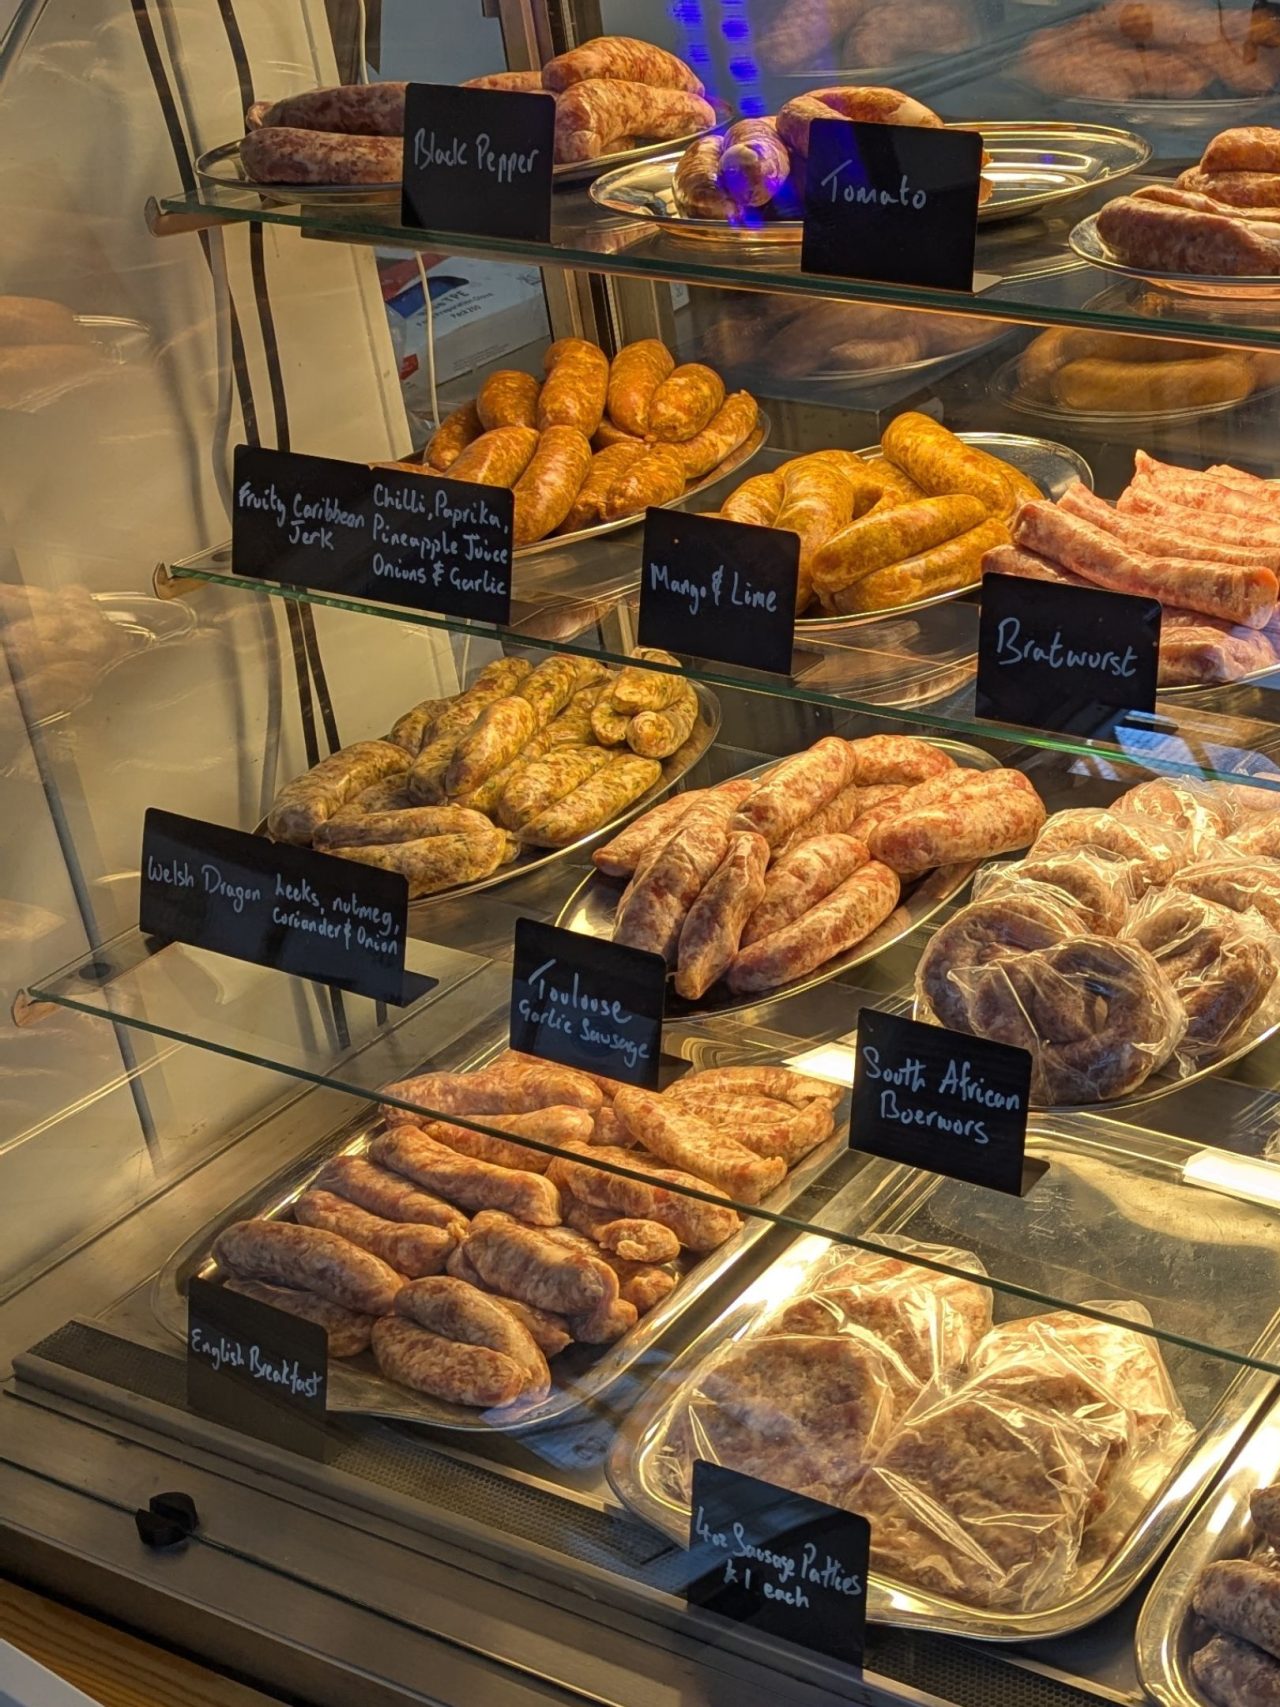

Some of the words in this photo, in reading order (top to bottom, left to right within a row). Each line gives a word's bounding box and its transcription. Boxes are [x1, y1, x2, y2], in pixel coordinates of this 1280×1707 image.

[413, 127, 468, 171] Black
[475, 132, 540, 183] Pepper
[820, 158, 928, 210] Tomato
[239, 481, 286, 528] Fruity
[292, 492, 365, 529] Caribbean
[435, 489, 509, 534] Paprika,
[288, 519, 335, 551] Jerk
[372, 512, 458, 560] Pineapple
[462, 533, 508, 565] Juice
[372, 551, 427, 584] Onions
[432, 560, 445, 587] &
[449, 566, 507, 595] Garlic
[650, 562, 707, 616] Mango
[711, 564, 725, 606] &
[731, 570, 777, 612] Lime
[996, 616, 1138, 677] Bratwurst
[147, 854, 195, 888] Welsh
[201, 864, 261, 913] Dragon
[275, 872, 325, 916] Leeks,
[332, 892, 400, 937] nutmeg,
[272, 906, 341, 939] Coriander
[356, 925, 398, 956] Onion
[528, 958, 633, 1024] Toulouse
[518, 998, 573, 1034] Garlic
[580, 1017, 651, 1069] Sausage
[862, 1045, 927, 1093] South
[938, 1058, 1020, 1111] African
[880, 1088, 990, 1144] Boerwors
[191, 1327, 245, 1371] English
[248, 1344, 323, 1398] Breakfast
[732, 1521, 795, 1584] Sausage
[801, 1542, 863, 1595] Patties
[763, 1581, 810, 1609] each
